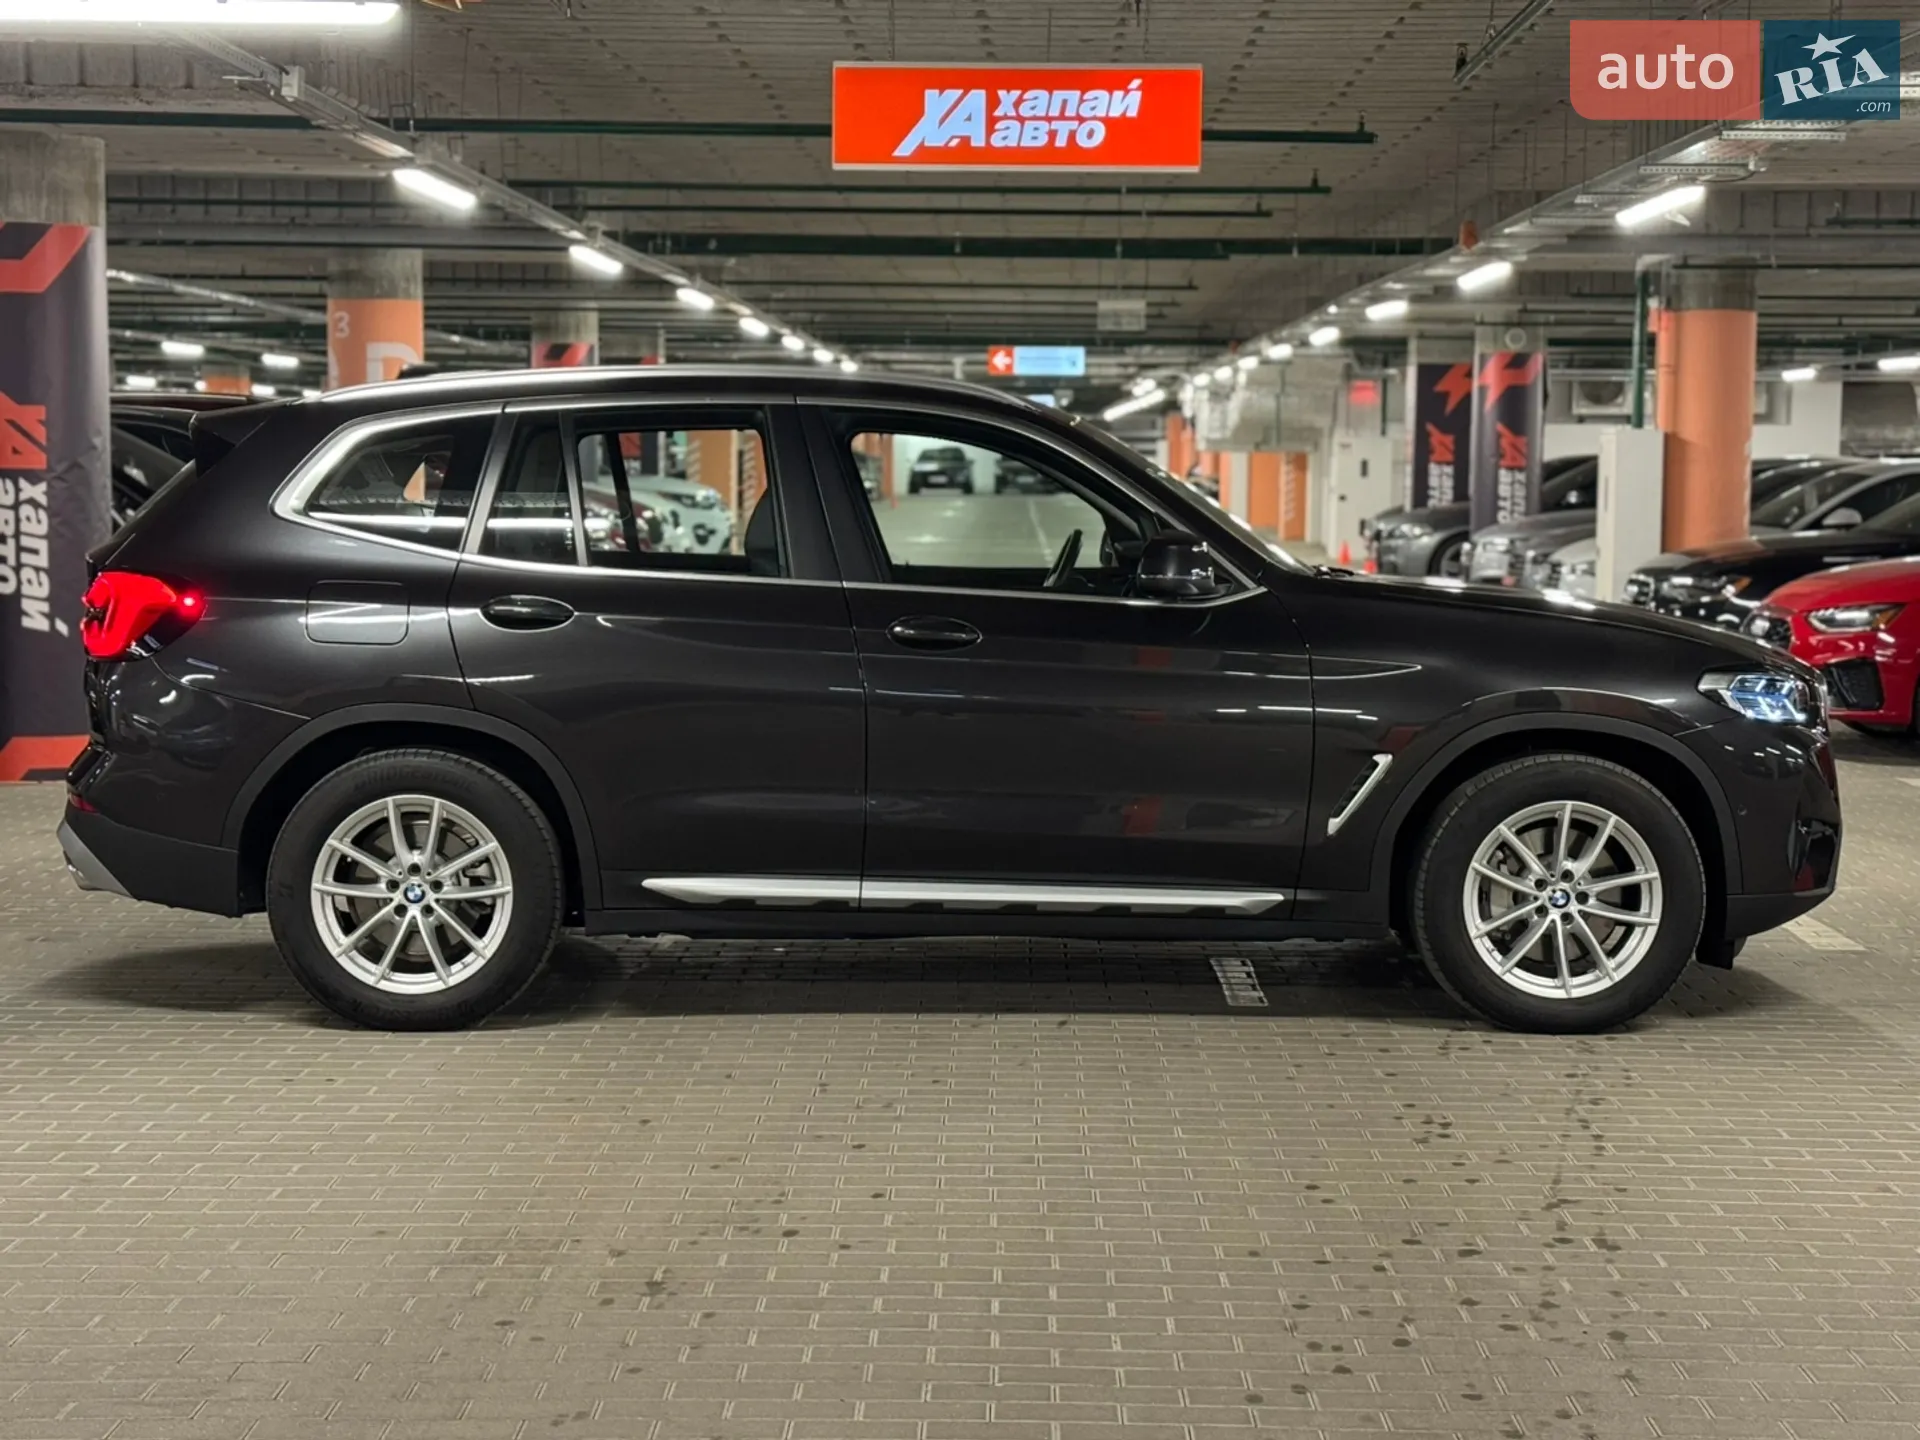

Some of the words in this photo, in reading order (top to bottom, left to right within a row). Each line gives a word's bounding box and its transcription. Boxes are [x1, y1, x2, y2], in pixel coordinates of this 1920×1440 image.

[993, 79, 1143, 117] хапай
[990, 120, 1106, 148] авто
[333, 311, 350, 338] 3
[18, 476, 69, 637] хапай
